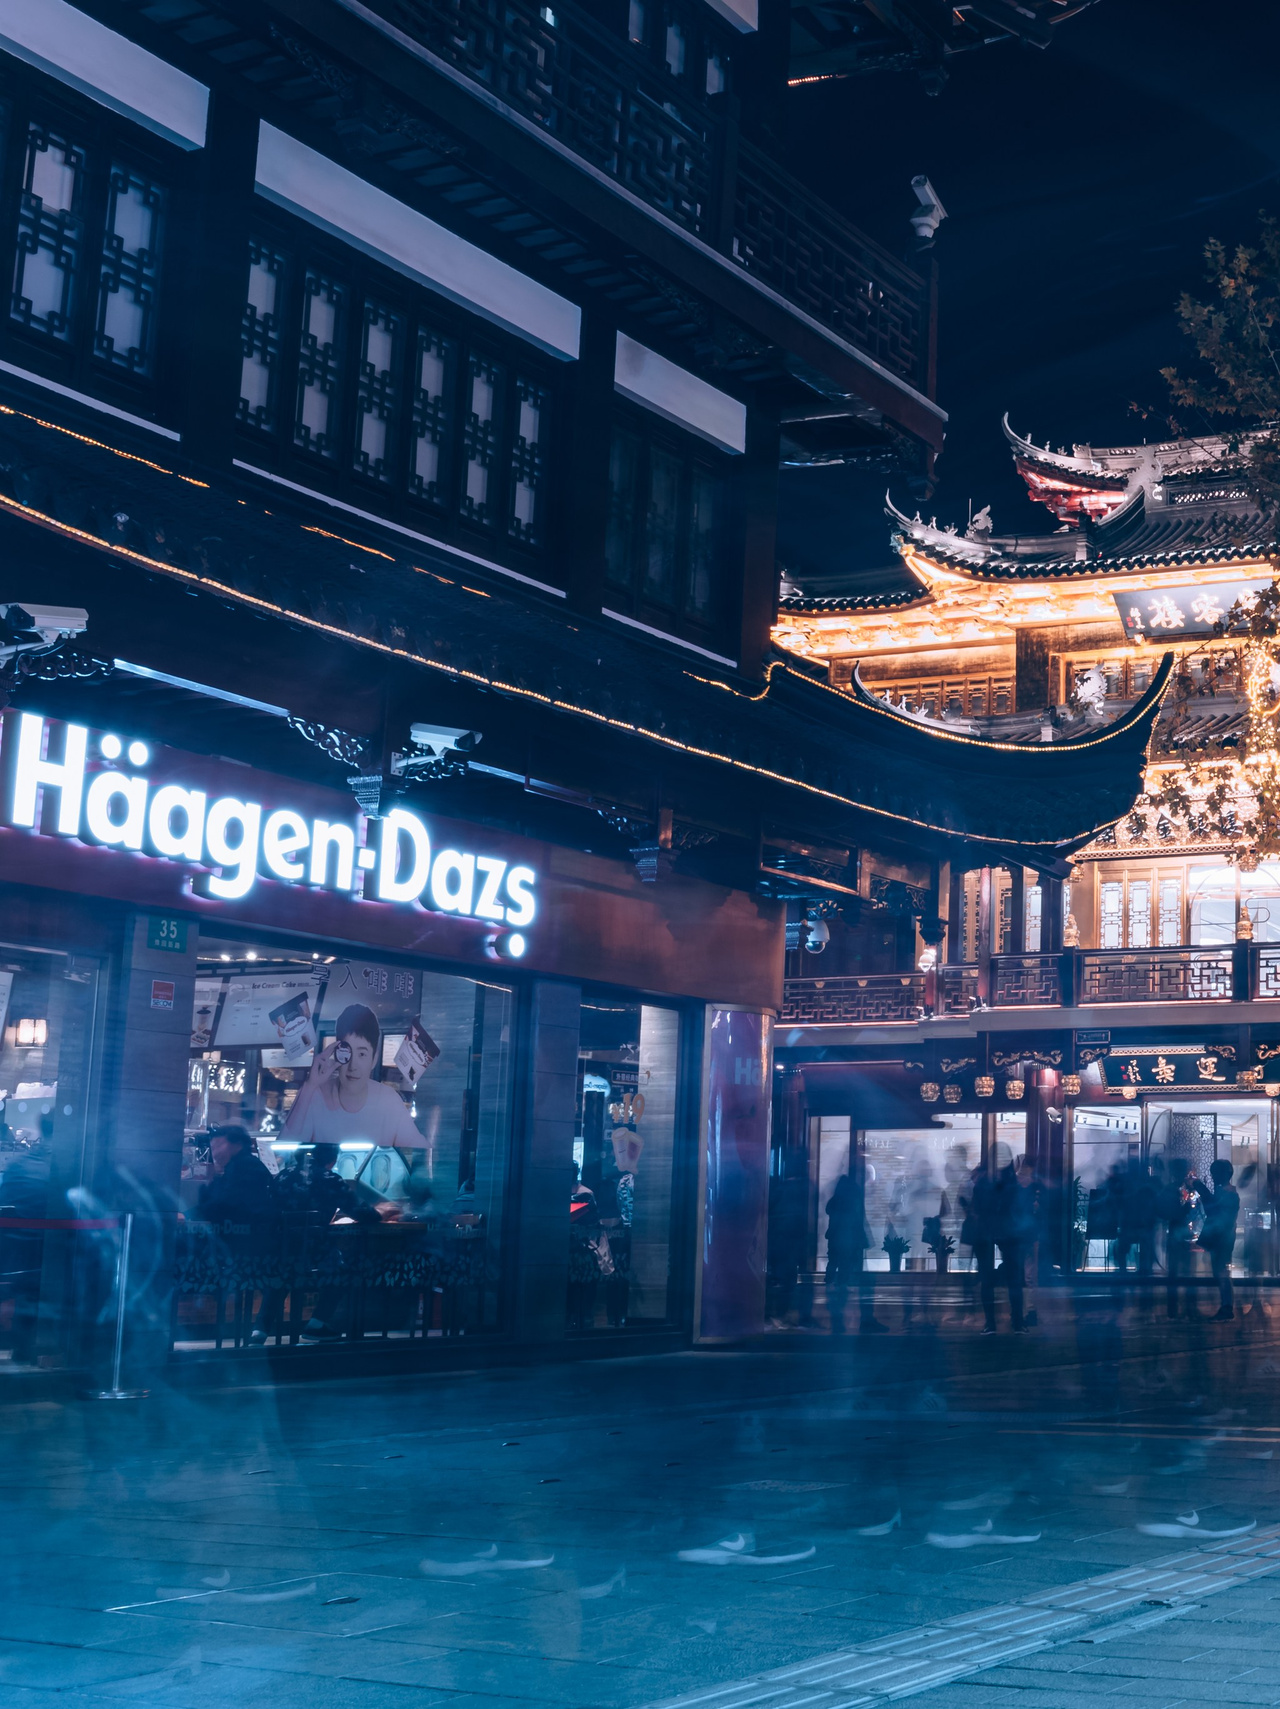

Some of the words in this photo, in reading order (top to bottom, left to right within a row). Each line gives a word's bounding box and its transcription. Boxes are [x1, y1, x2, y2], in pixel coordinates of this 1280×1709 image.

[12, 713, 536, 927] Häagen-Dazs
[159, 919, 178, 939] 35
[251, 982, 261, 990] Ice
